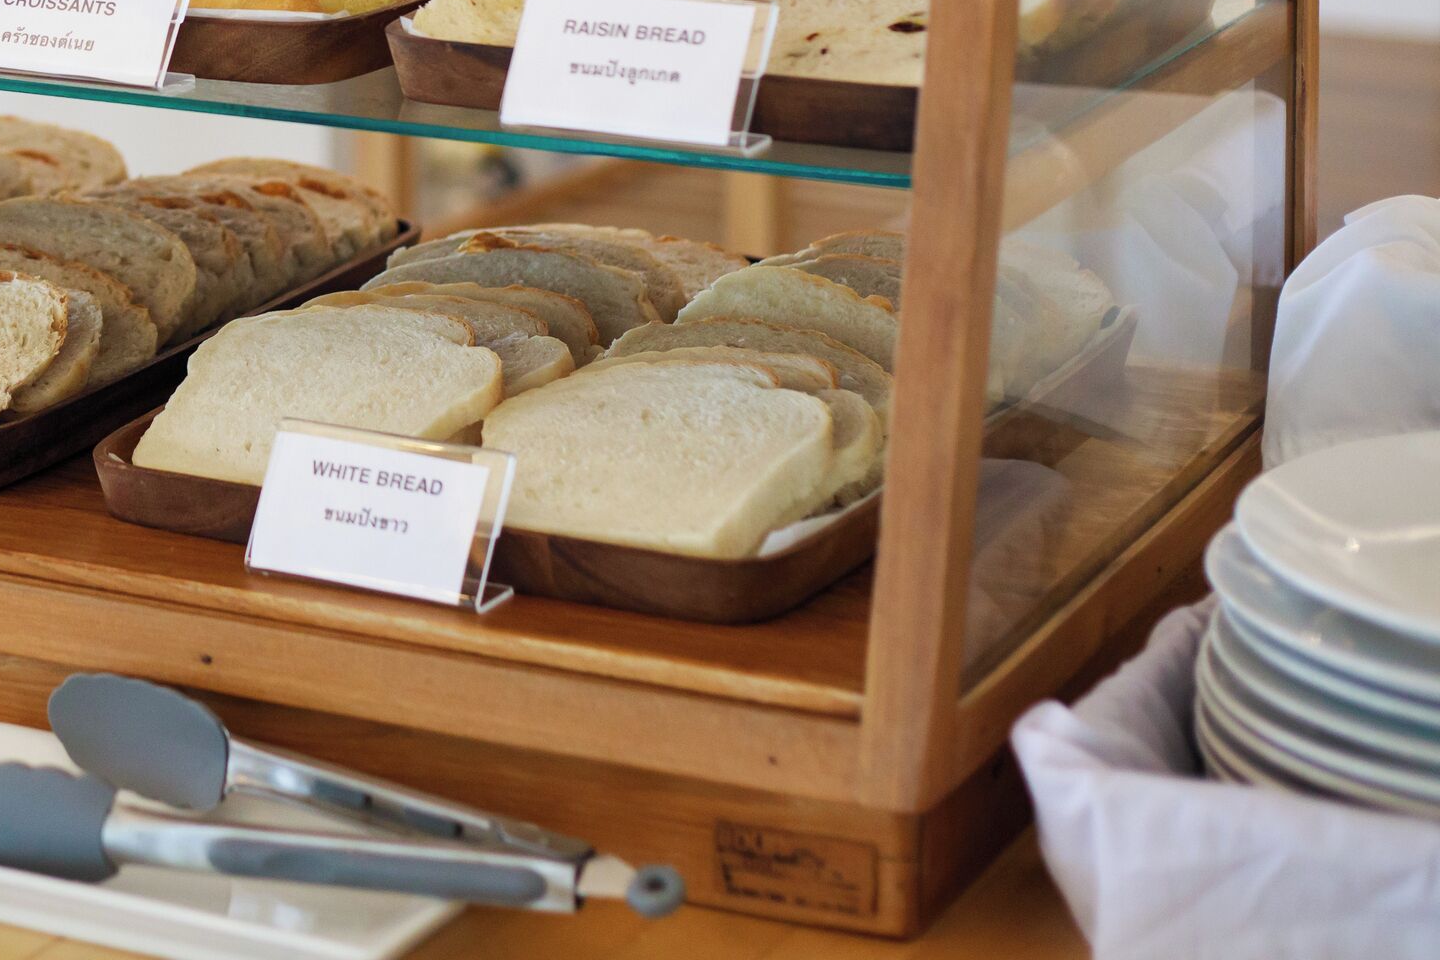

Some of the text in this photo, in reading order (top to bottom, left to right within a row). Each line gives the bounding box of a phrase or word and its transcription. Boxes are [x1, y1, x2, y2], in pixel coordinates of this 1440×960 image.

[563, 19, 707, 46] RAISIN BREAD
[312, 459, 444, 496] WHITE BREAD
